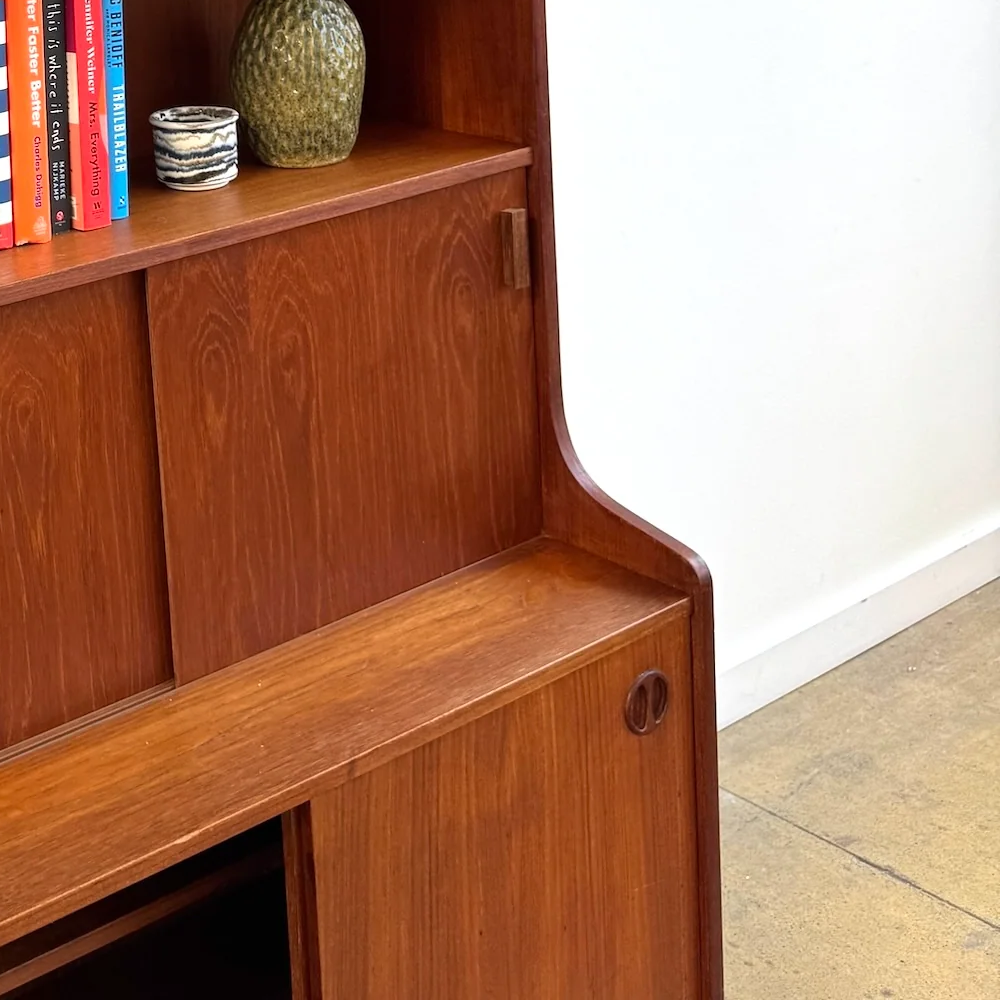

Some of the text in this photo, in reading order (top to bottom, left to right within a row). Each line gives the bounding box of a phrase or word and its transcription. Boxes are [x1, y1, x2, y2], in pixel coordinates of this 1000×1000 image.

[46, 3, 62, 31] this
[27, 26, 39, 76] Faster
[48, 38, 59, 49] is
[110, 12, 124, 68] BENIOFF
[48, 55, 61, 98] where
[86, 46, 96, 94] Weiner
[30, 80, 41, 128] Better
[50, 103, 63, 114] it
[89, 101, 98, 128] Mrs.
[51, 121, 65, 151] ends
[112, 83, 128, 173] TRAILBLAZER
[34, 136, 43, 172] Charles
[89, 132, 102, 196] Everything
[35, 174, 43, 208] Duhigg
[52, 161, 60, 201] NIJKAMP
